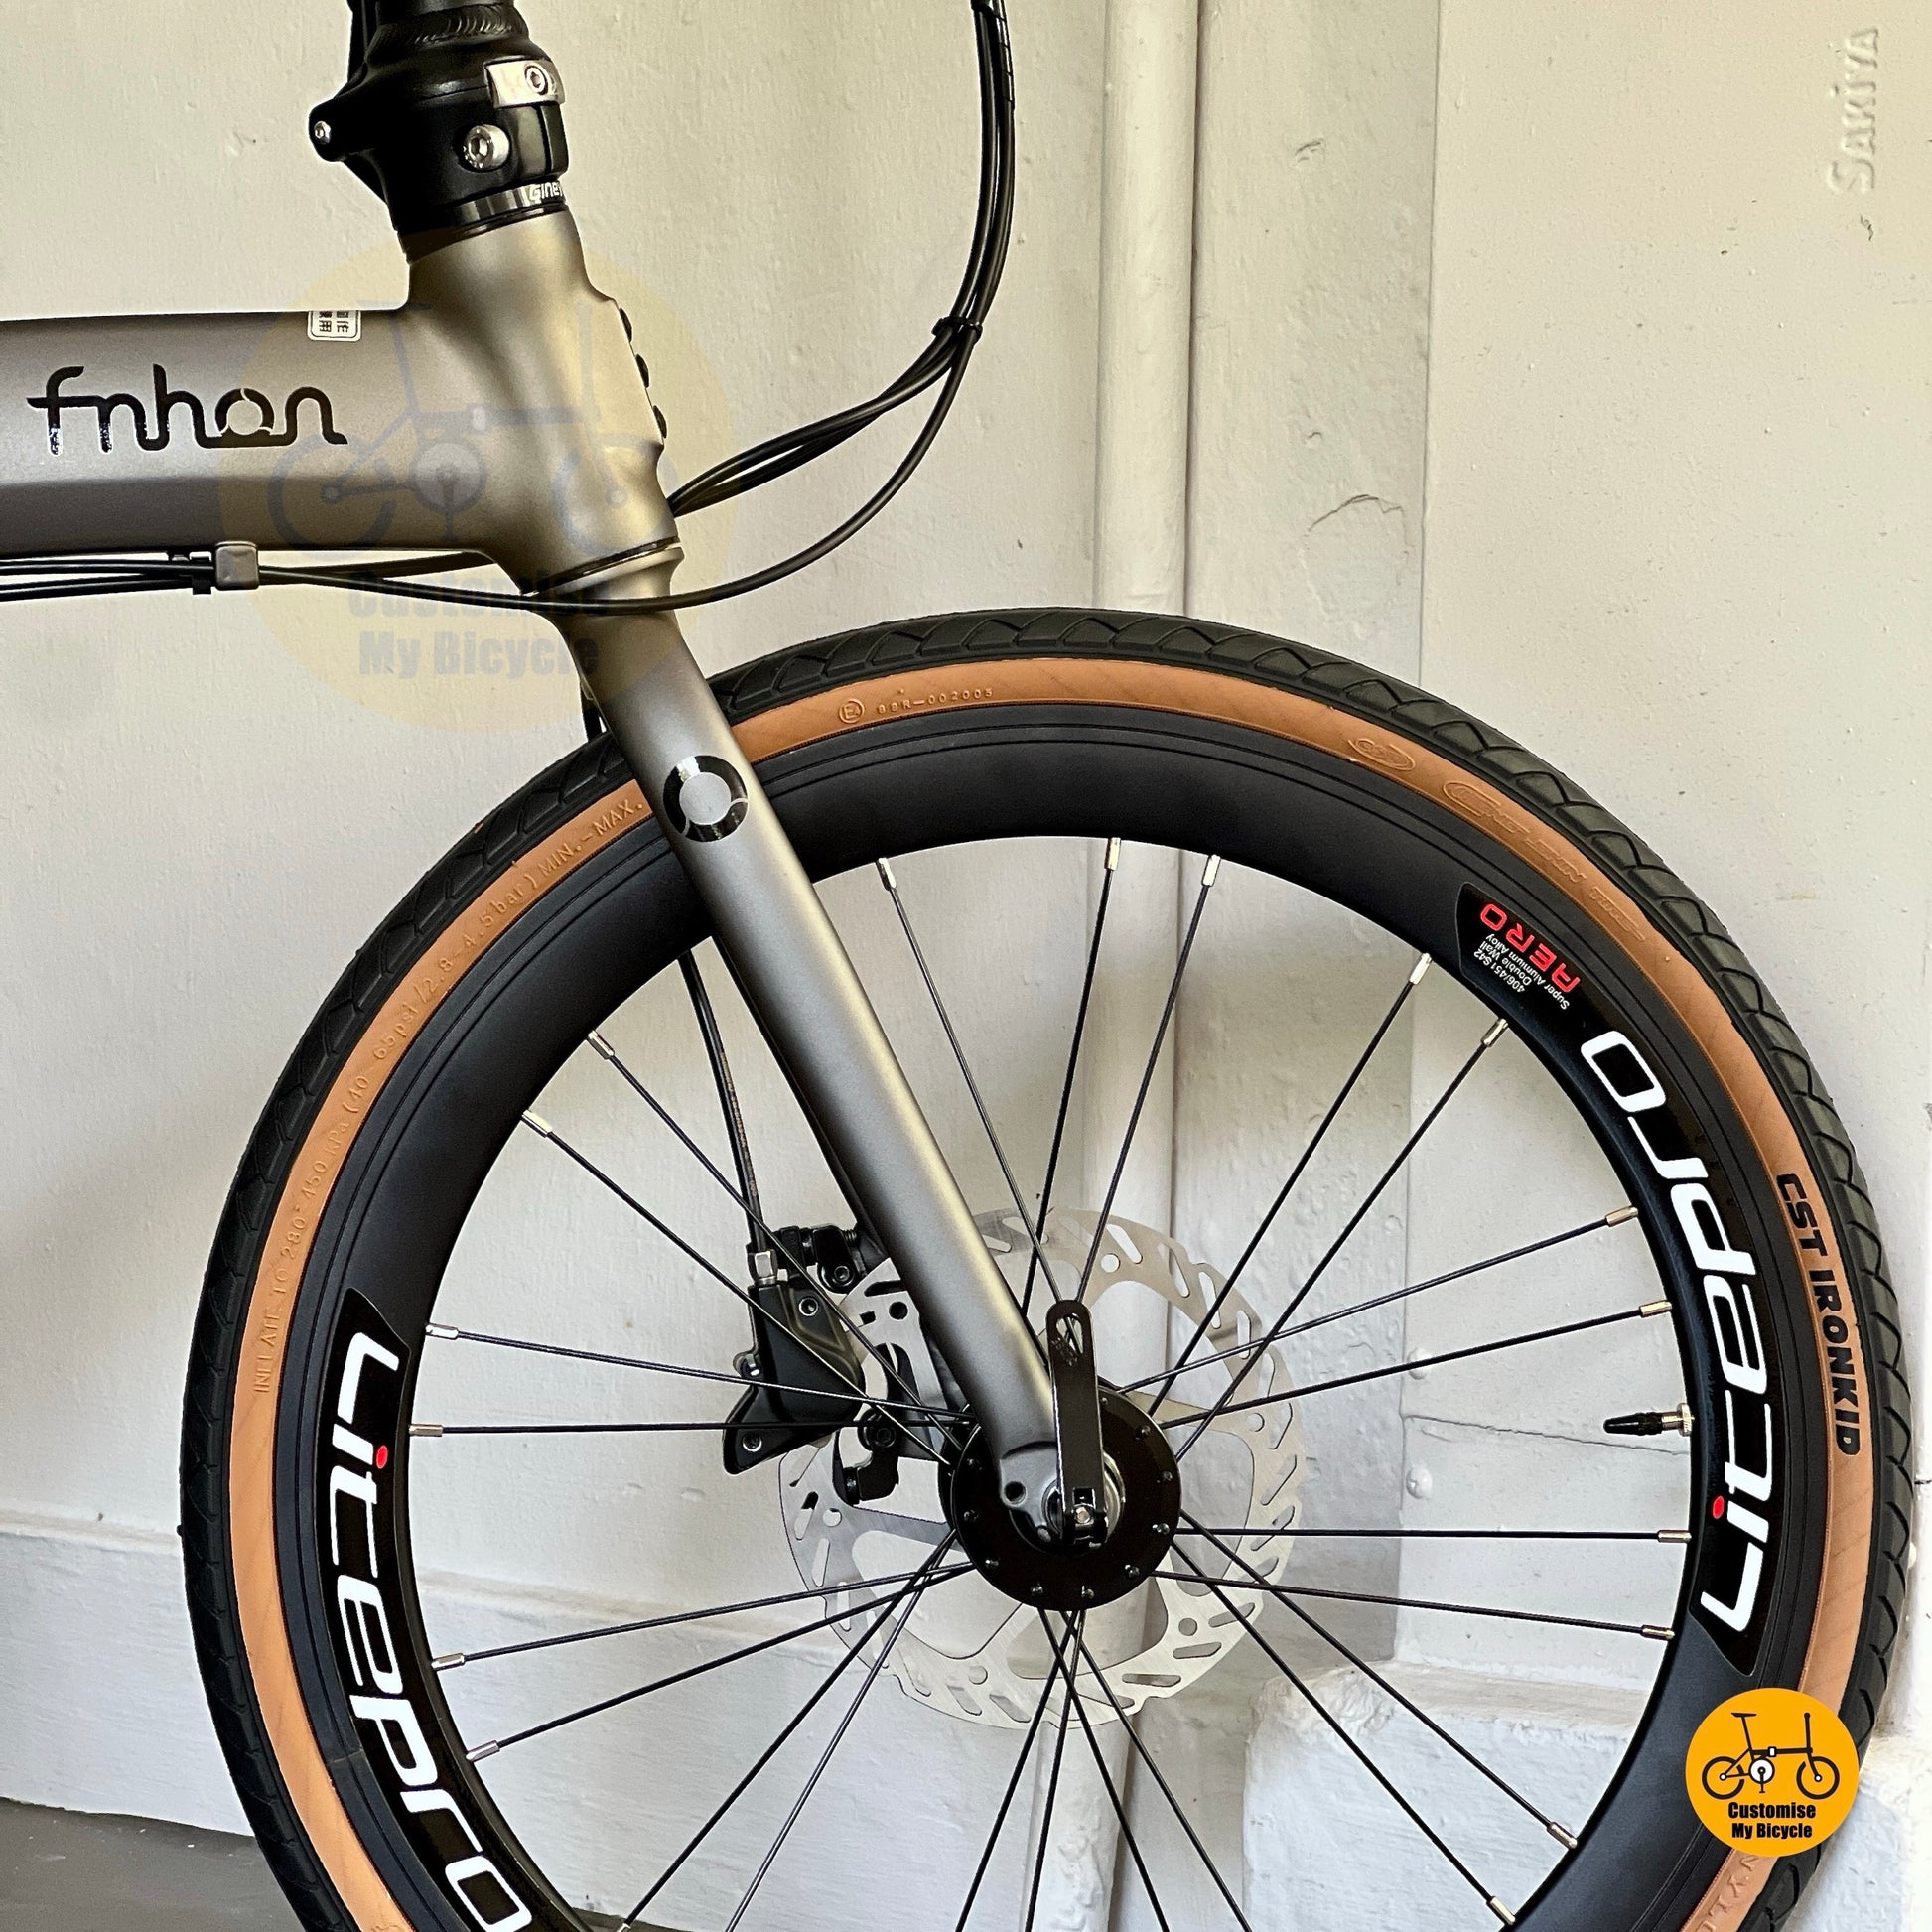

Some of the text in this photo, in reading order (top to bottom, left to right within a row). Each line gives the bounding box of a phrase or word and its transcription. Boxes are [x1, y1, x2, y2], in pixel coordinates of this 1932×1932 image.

[26, 364, 347, 455] fnhon
[1473, 948, 1525, 993] 406/451 S42
[1479, 940, 1532, 986] Double Wall
[1480, 903, 1582, 993] AERO
[1485, 933, 1511, 954] Alloy
[1544, 984, 1571, 1010] Super
[1581, 1031, 1773, 1632] Litepro
[1777, 1173, 1862, 1456] CST IRONKID
[329, 1331, 532, 1932] Litepro
